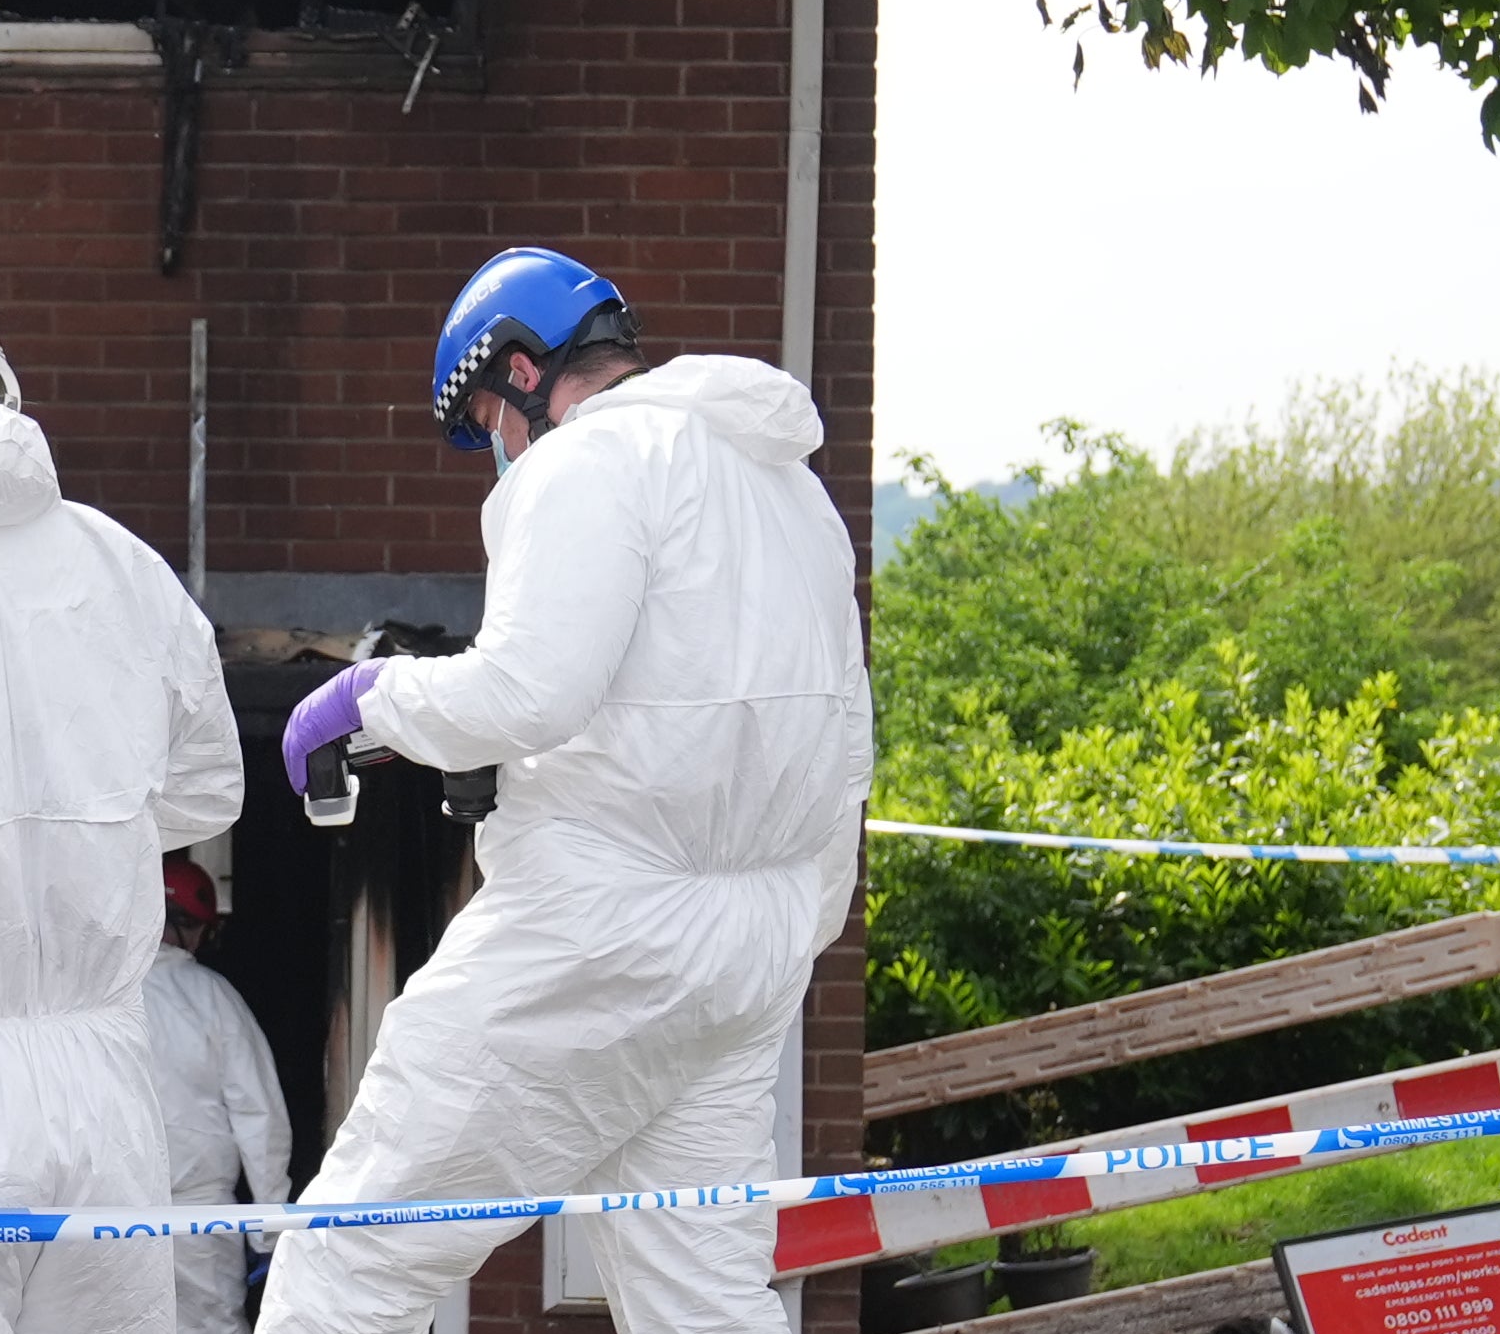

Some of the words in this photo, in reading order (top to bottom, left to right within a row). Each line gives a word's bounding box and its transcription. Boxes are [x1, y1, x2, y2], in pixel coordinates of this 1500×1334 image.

[445, 281, 502, 338] POLICE
[1422, 1132, 1449, 1142] 555
[1455, 1128, 1478, 1138] 111
[1106, 1137, 1275, 1173] POLICE
[919, 1180, 946, 1191] 555
[952, 1177, 975, 1187] 111
[368, 1202, 538, 1224] CRIMESTOPPERS
[1382, 1225, 1448, 1246] Cadent
[1355, 1265, 1500, 1299] cadentgas.com/works
[1385, 1292, 1444, 1306] EMERGENCY
[1446, 1286, 1464, 1297] TEL
[1383, 1308, 1432, 1328] 0800
[1433, 1304, 1457, 1319] 111
[1460, 1297, 1494, 1314] 999
